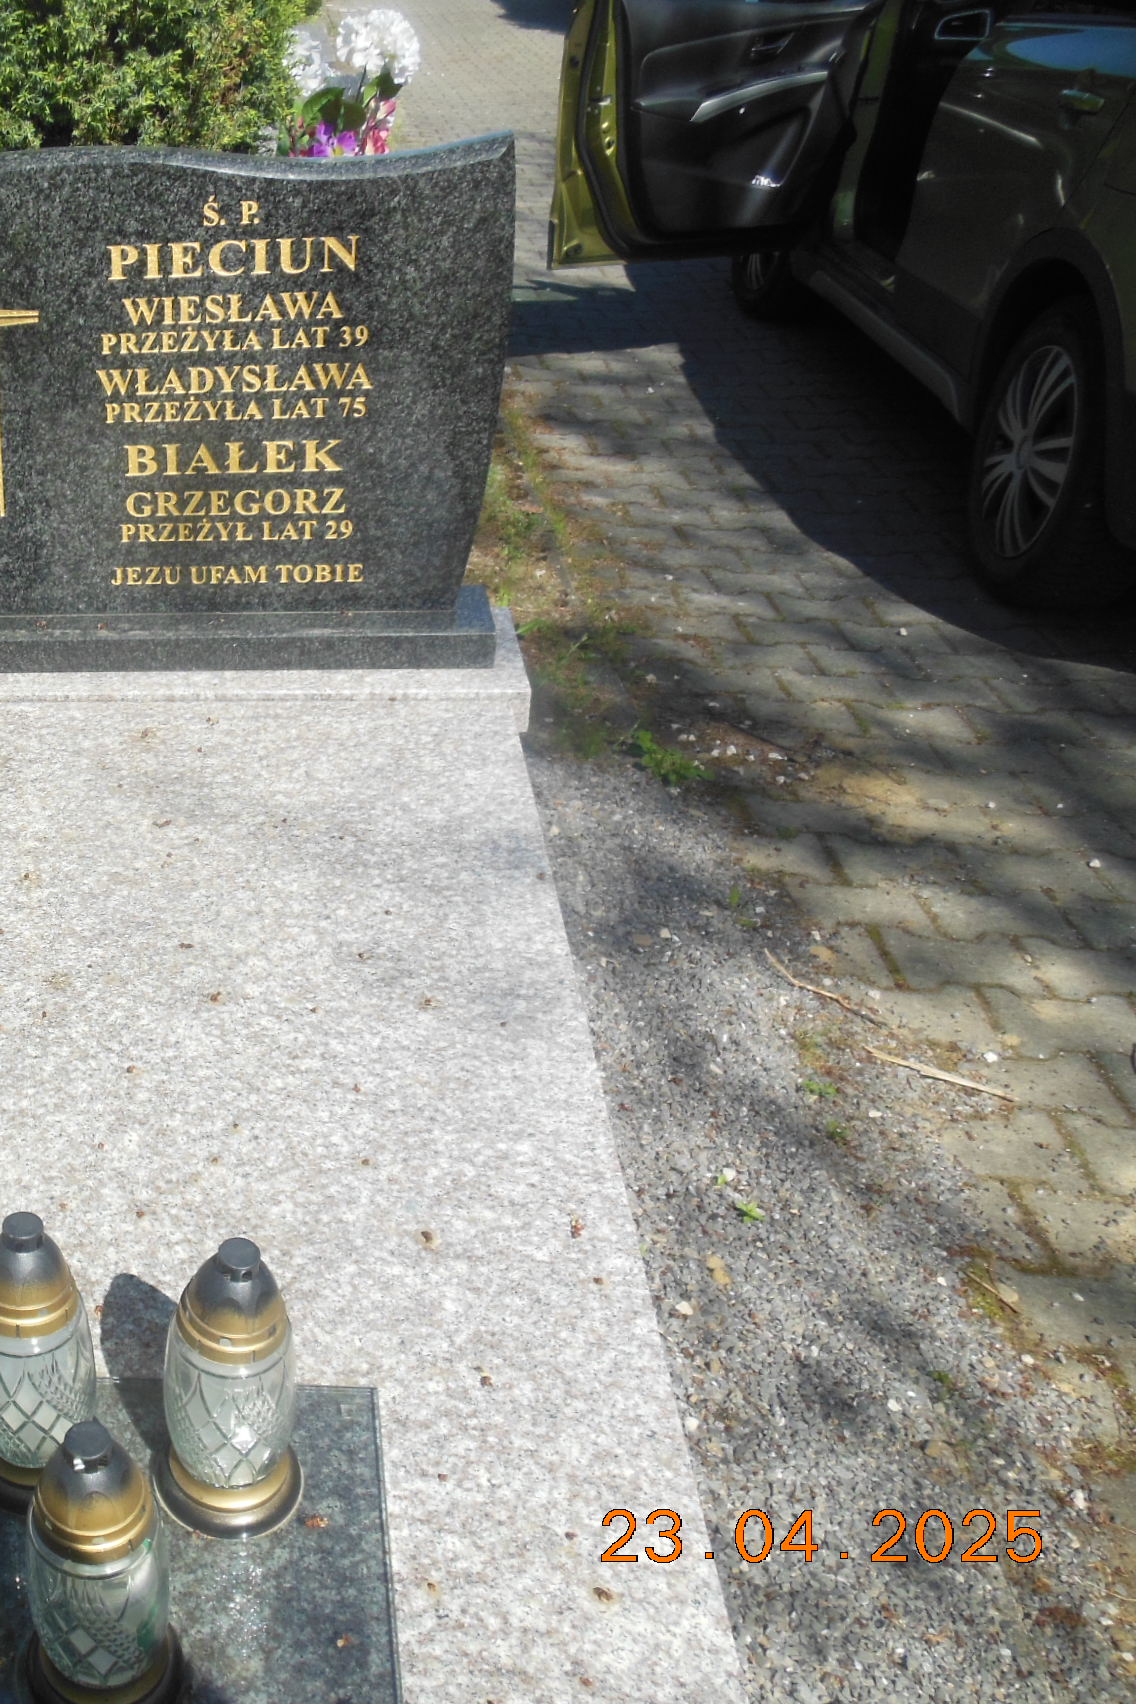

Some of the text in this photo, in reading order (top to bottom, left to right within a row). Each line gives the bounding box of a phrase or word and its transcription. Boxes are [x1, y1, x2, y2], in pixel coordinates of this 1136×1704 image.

[202, 195, 261, 227] Ś. P.
[107, 234, 361, 281] PIECIUN
[122, 290, 345, 327] WIESŁAWA
[100, 325, 371, 355] PRZEŻYŁA LAT 39
[95, 362, 375, 397] WŁADYSŁAWA
[104, 396, 369, 424] PRZEŻYŁA LAT 75
[124, 438, 343, 478] BIAŁEK
[125, 487, 347, 518] GRZEGORZ
[120, 518, 354, 543] PRZEŻYŁ LAT 29
[111, 563, 364, 586] JEZU UFAM TOBIE
